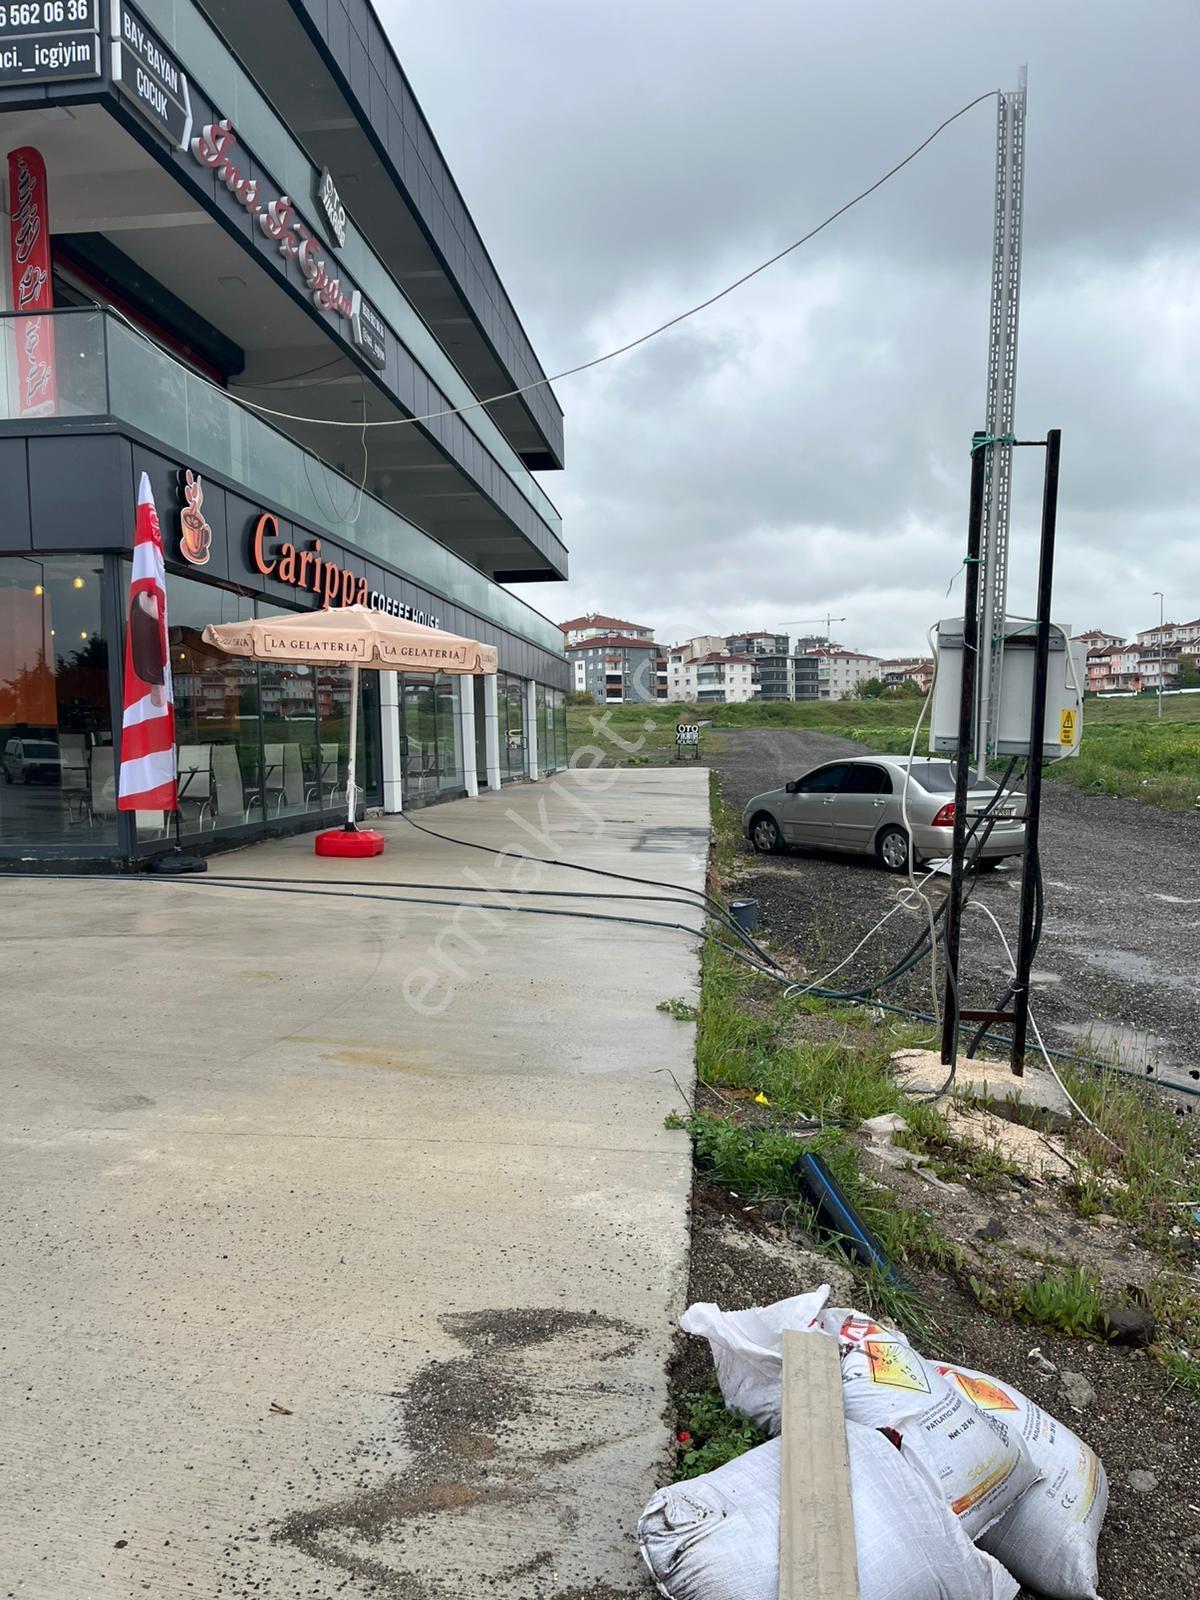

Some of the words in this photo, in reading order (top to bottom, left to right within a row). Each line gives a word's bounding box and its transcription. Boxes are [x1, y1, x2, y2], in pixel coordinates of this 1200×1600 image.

[10, 3, 40, 26] 562
[44, 2, 64, 23] 06
[68, 0, 88, 20] 36
[123, 12, 178, 94] BAY-BAYAN
[136, 67, 168, 121] ÇOCUK
[254, 513, 369, 610] Carippa
[371, 591, 410, 620] COFFEE
[271, 640, 286, 648] LA
[290, 640, 358, 652] GELATERIA
[385, 646, 397, 656] LA
[401, 647, 460, 660] GELATERIA
[678, 724, 699, 733] OTO
[925, 1409, 954, 1432] PATLAYICI
[948, 1427, 961, 1440] Net
